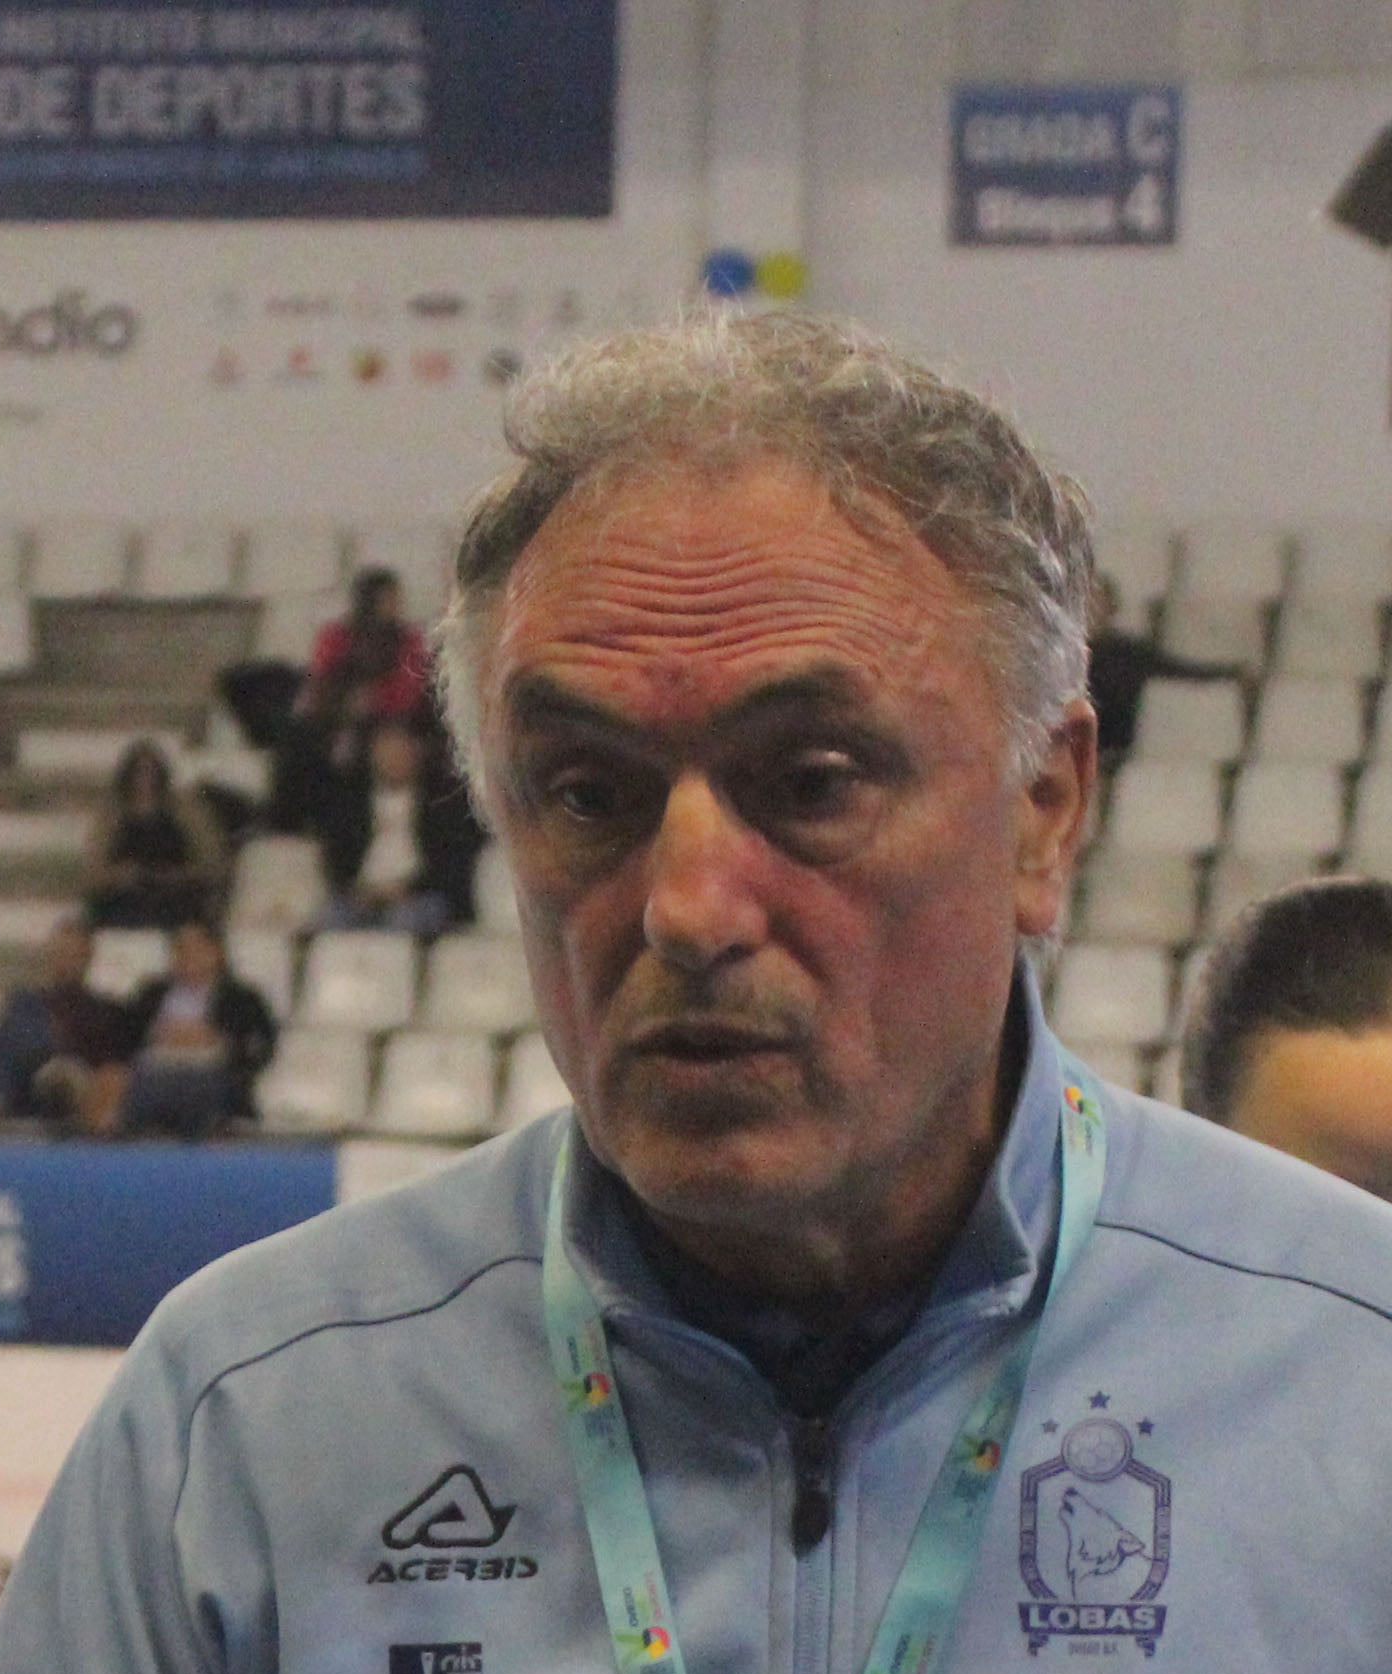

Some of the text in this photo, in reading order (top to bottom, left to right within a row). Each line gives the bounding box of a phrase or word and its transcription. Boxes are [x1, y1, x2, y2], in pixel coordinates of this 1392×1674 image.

[94, 66, 427, 136] DEPORTES
[366, 1555, 539, 1584] ACERBIS
[1028, 1606, 1157, 1630] LOBAS
